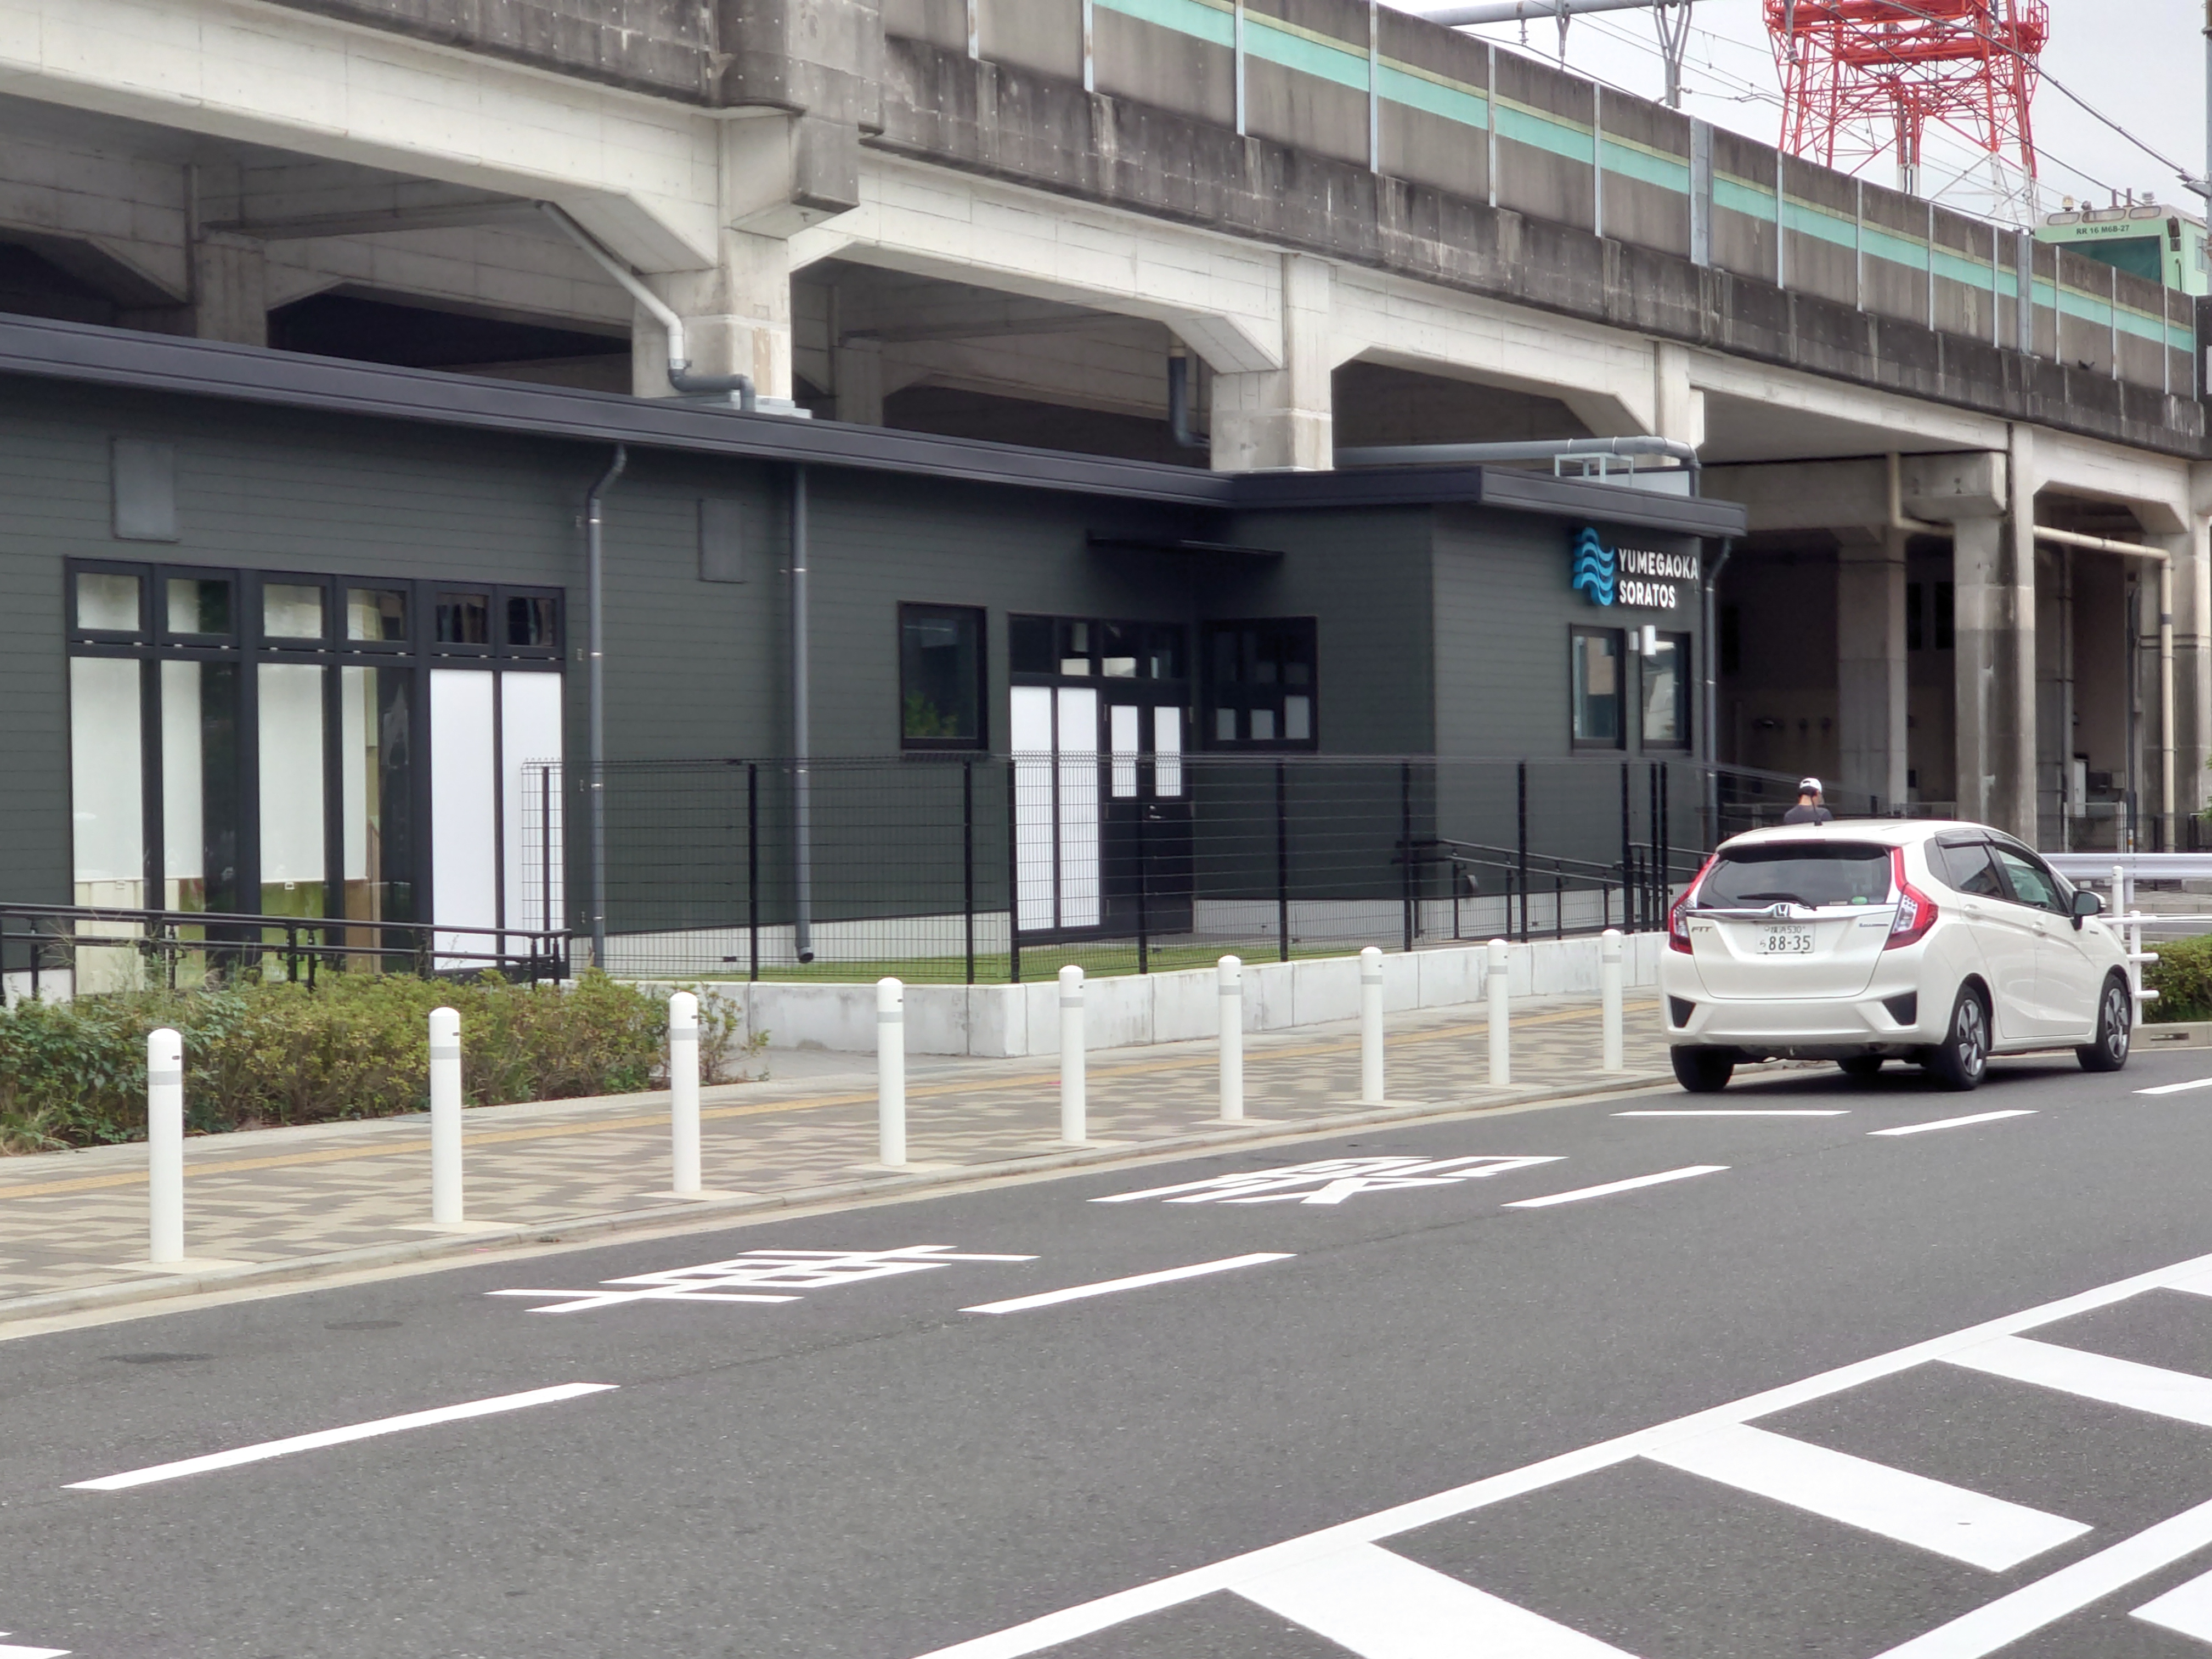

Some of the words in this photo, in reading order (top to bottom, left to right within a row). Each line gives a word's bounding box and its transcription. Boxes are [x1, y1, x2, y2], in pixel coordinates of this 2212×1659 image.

[1618, 548, 1699, 579] YUMEGAOKA
[1619, 580, 1675, 608] SORATOS
[1769, 935, 1811, 951] 88-35
